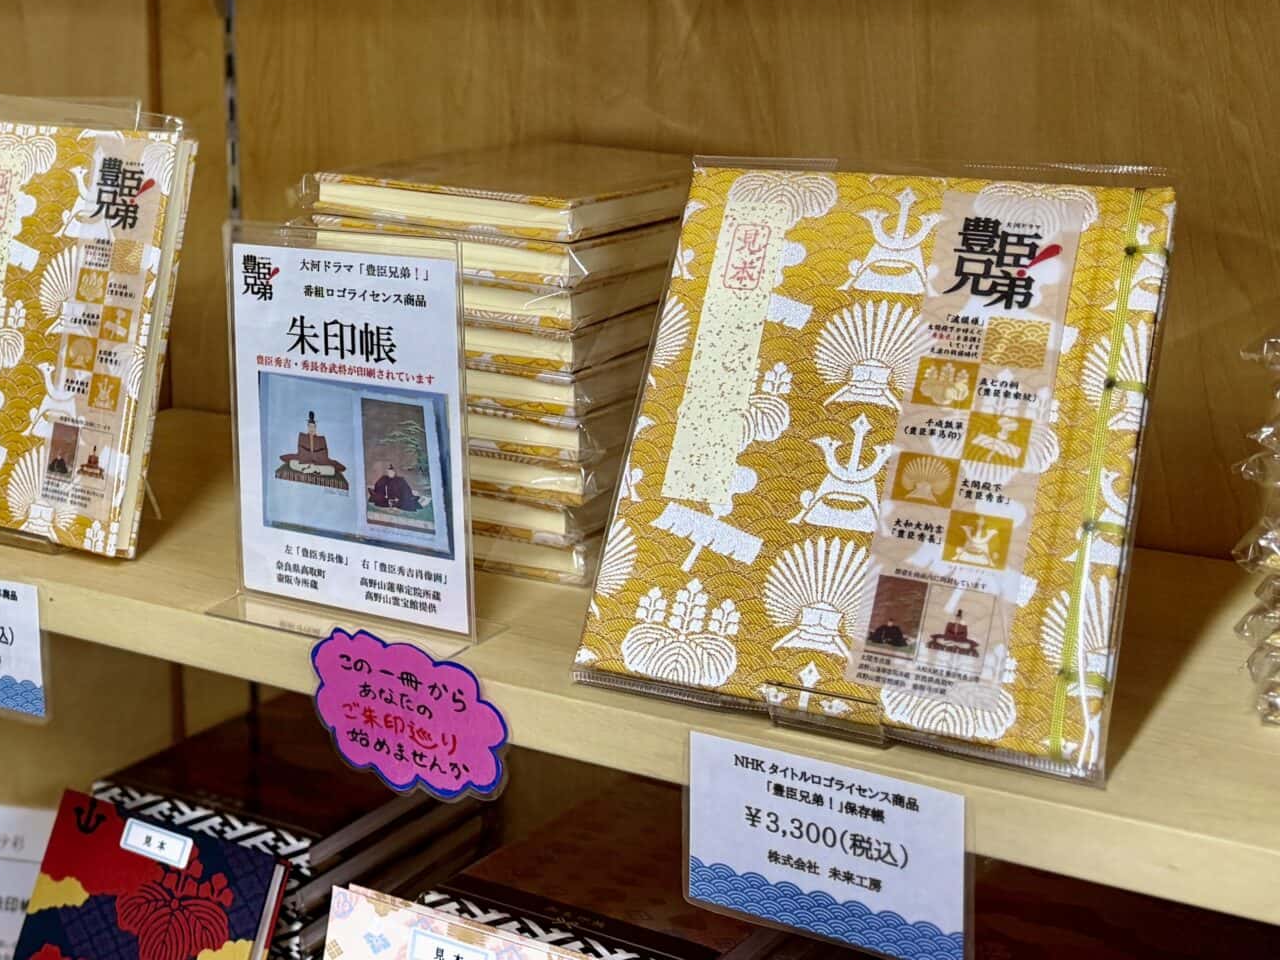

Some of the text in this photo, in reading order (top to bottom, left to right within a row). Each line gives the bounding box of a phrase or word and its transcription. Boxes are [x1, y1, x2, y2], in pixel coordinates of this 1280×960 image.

[729, 228, 764, 285] 見本
[303, 284, 427, 308] 番組ロゴライセンス商品
[286, 314, 397, 365] 朱印帳
[359, 681, 434, 720] あなたの
[341, 701, 458, 756] ご朱印巡り
[346, 727, 471, 780] 始めませんか
[734, 753, 921, 813] NHK タイトルロゴライセンス商品
[142, 834, 168, 850] 見本
[744, 804, 910, 870] ¥3,300(税込)
[767, 849, 883, 894] 株式会社 未来工房
